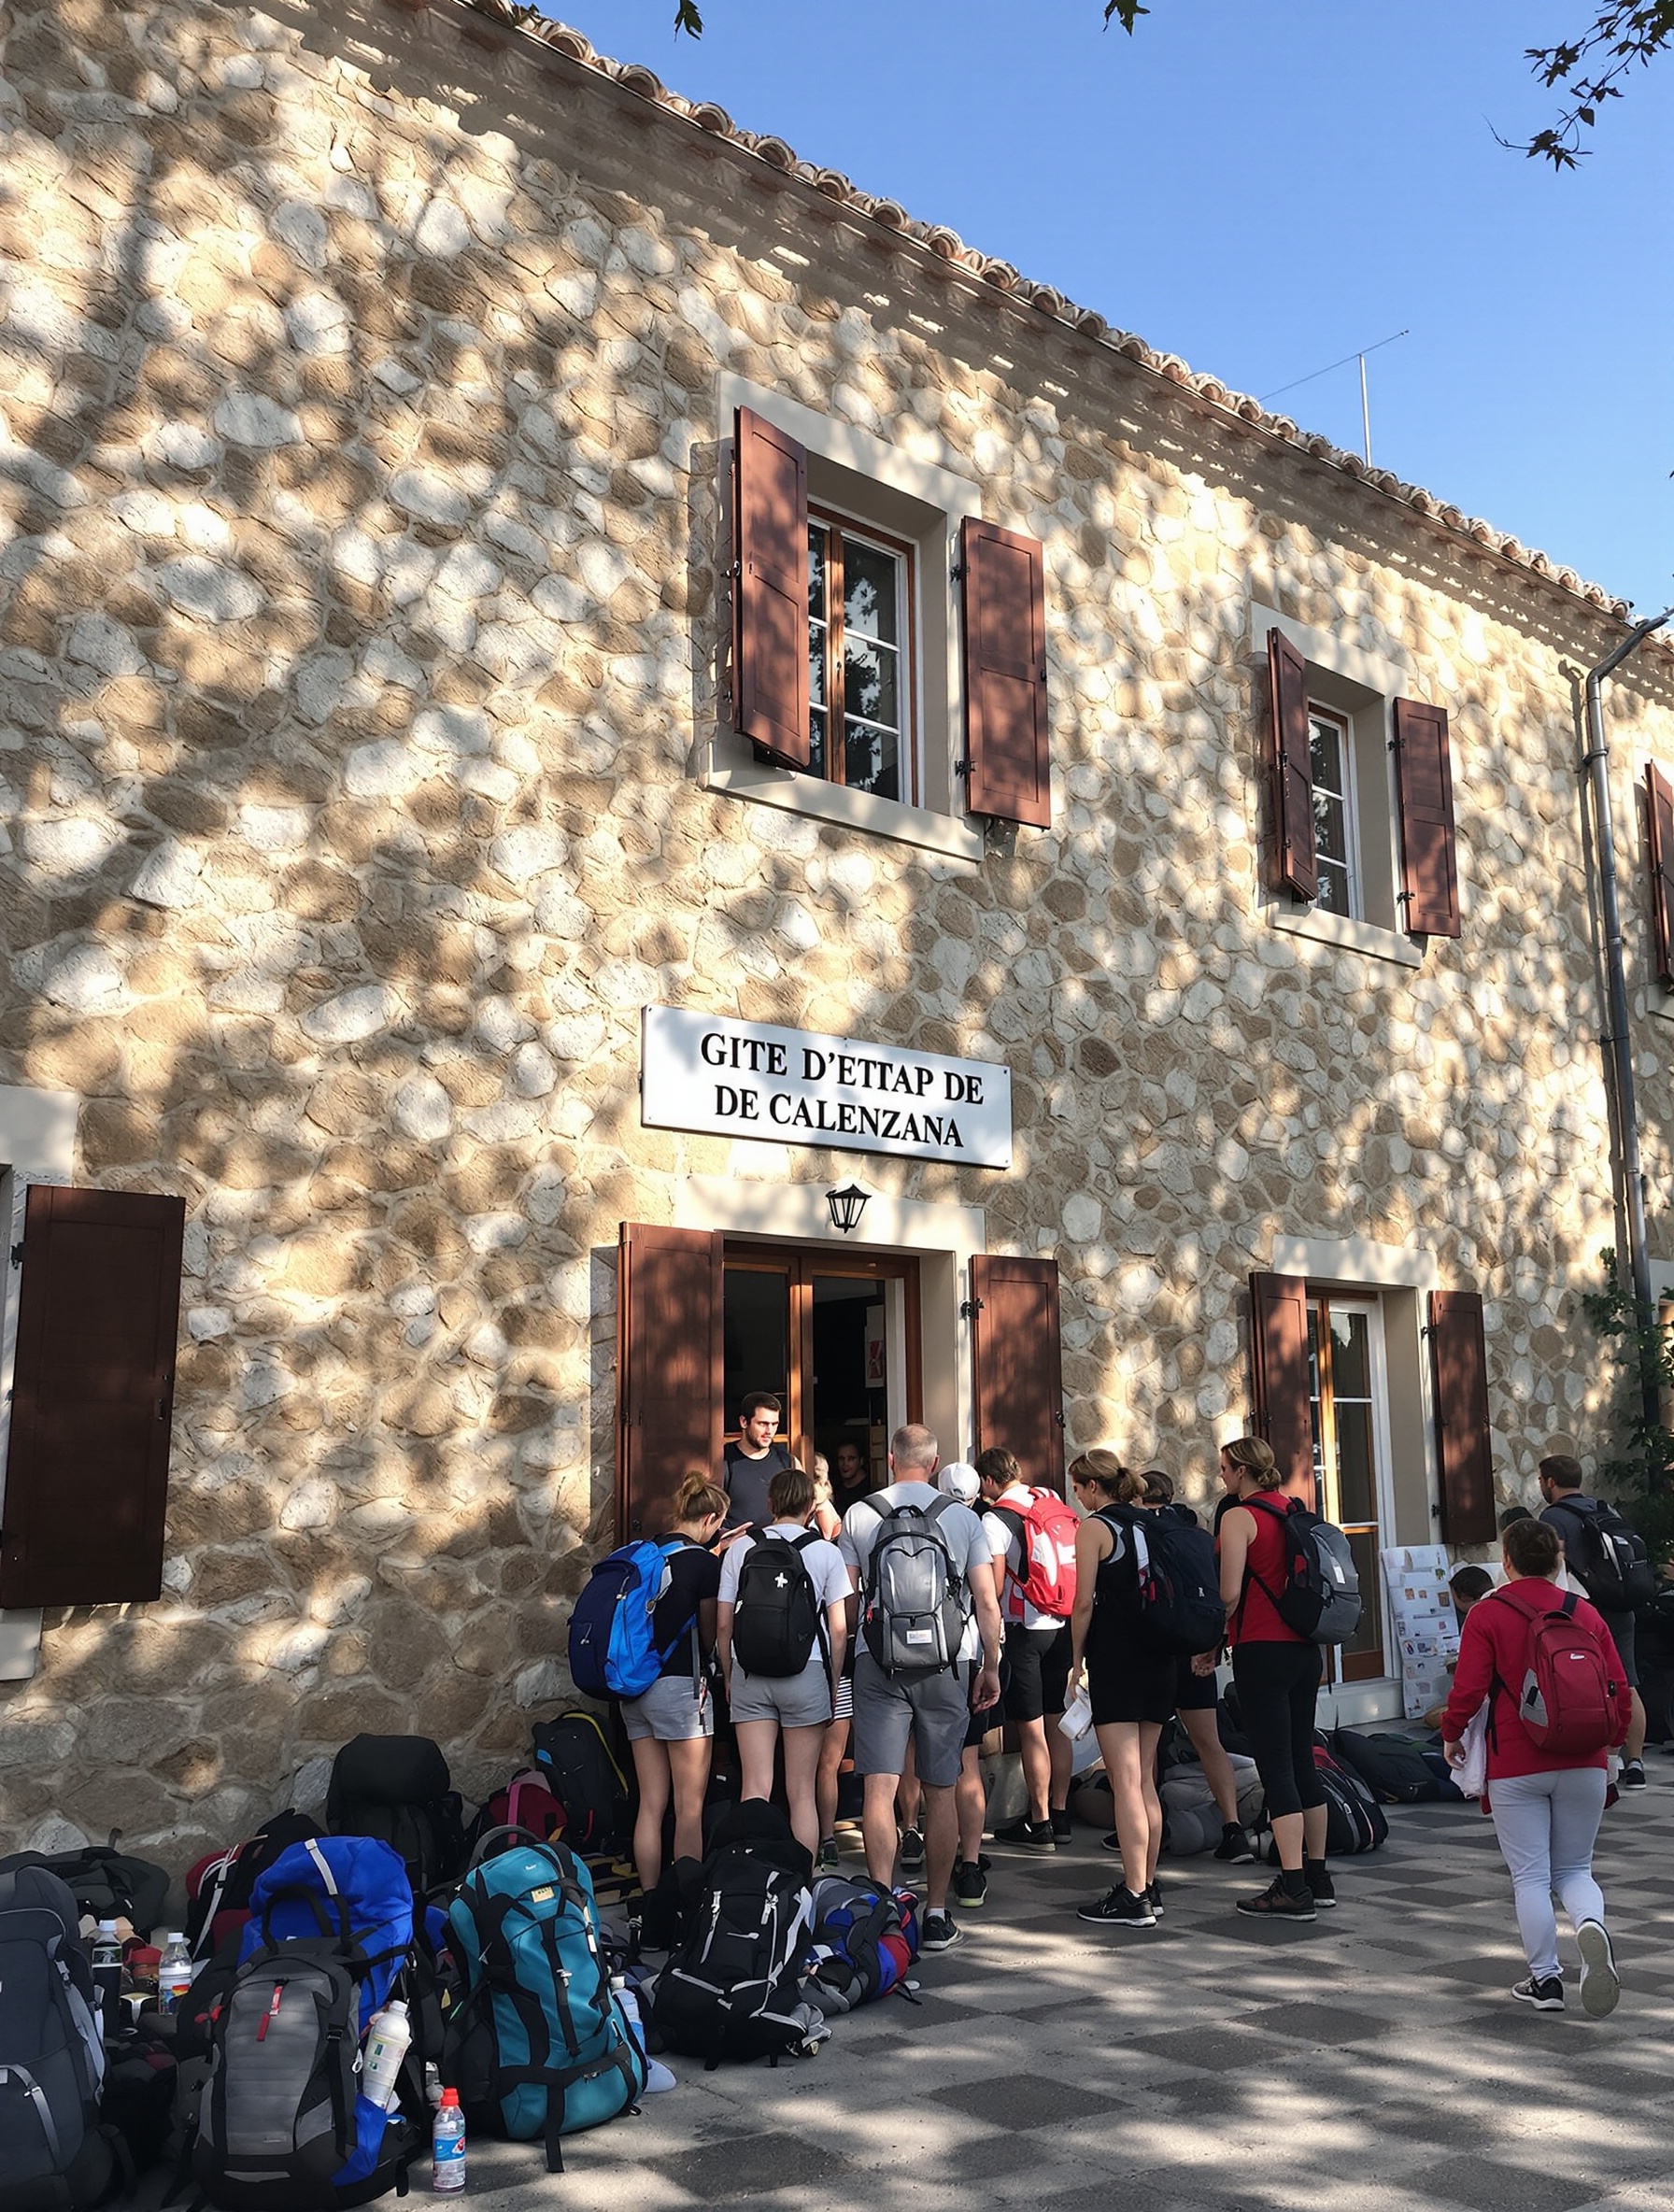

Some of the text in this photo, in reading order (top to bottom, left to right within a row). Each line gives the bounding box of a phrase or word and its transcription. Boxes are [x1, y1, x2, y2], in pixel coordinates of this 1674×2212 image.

[700, 1032, 985, 1105] GITE D'ETTAP DE
[715, 1085, 965, 1148] DE CALENZANA
